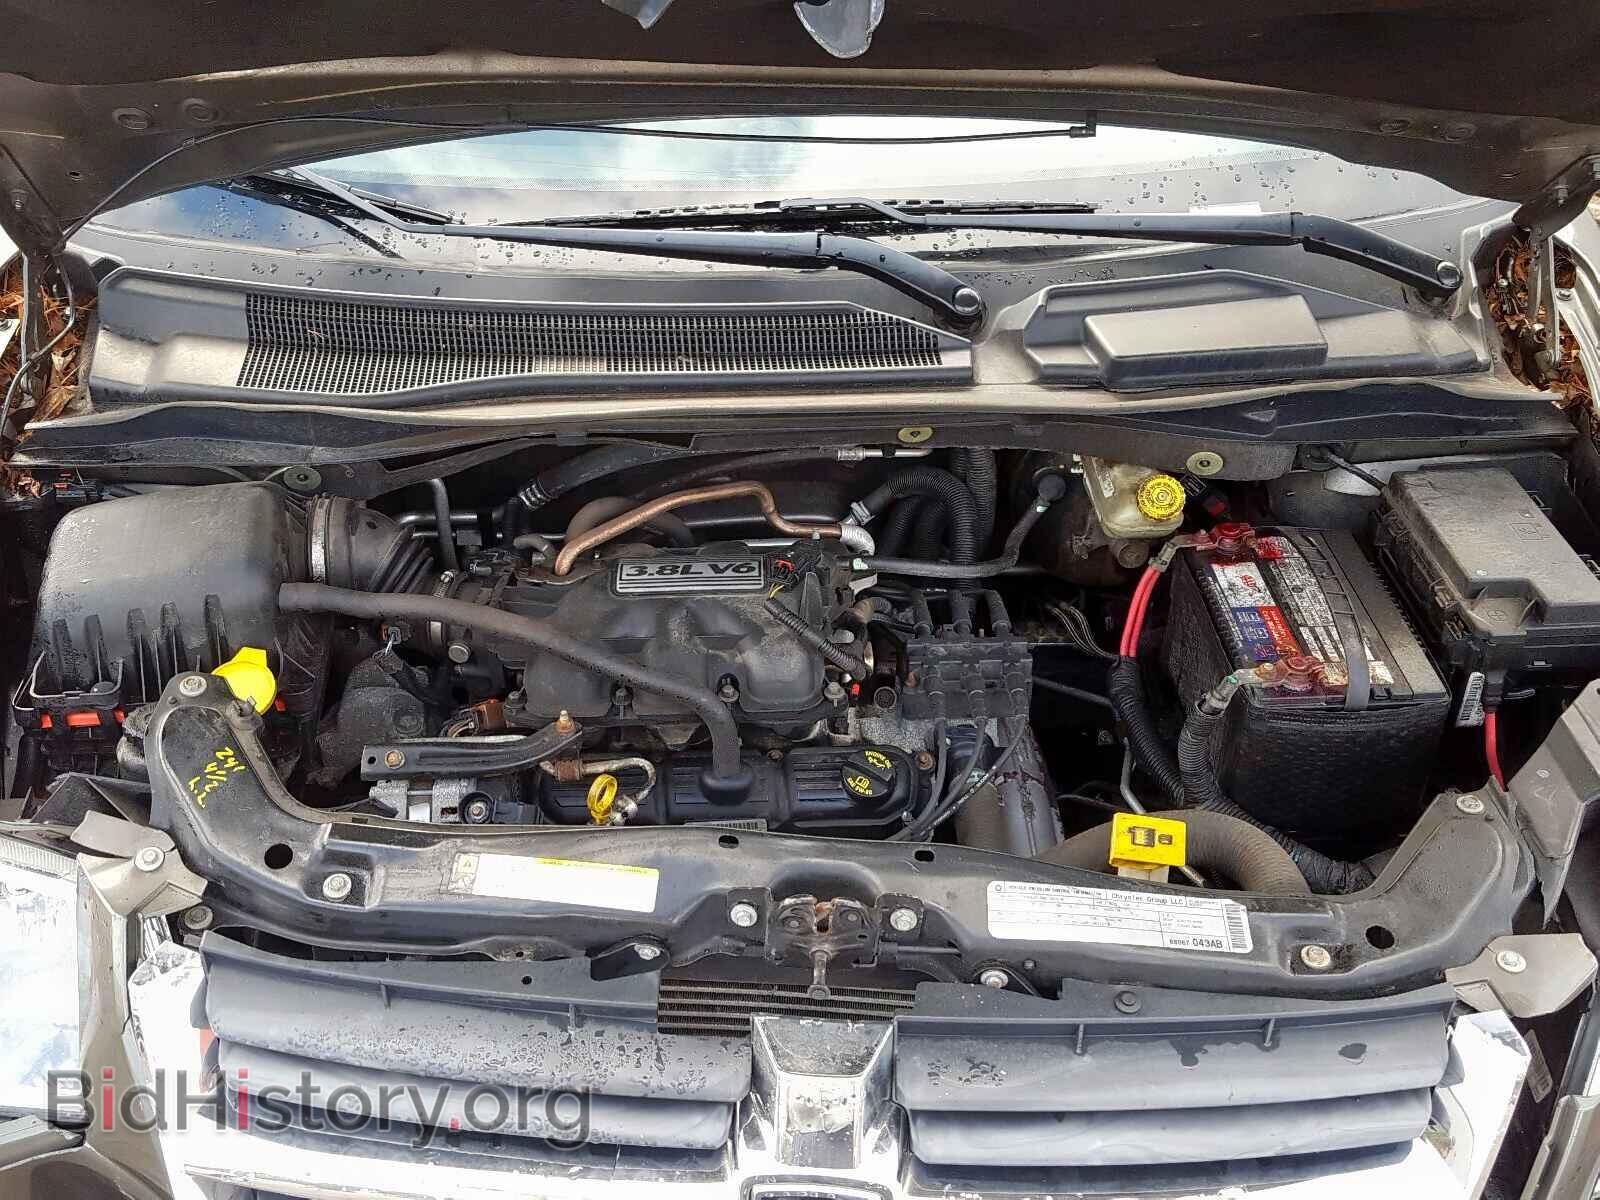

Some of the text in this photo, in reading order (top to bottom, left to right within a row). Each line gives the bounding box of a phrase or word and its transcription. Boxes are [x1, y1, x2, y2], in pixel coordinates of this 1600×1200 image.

[626, 562, 757, 577] 3.8L V6
[1111, 892, 1143, 903] Chrysler
[1147, 896, 1168, 905] Group
[1170, 897, 1184, 905] LLC
[1192, 937, 1223, 949] 043AB
